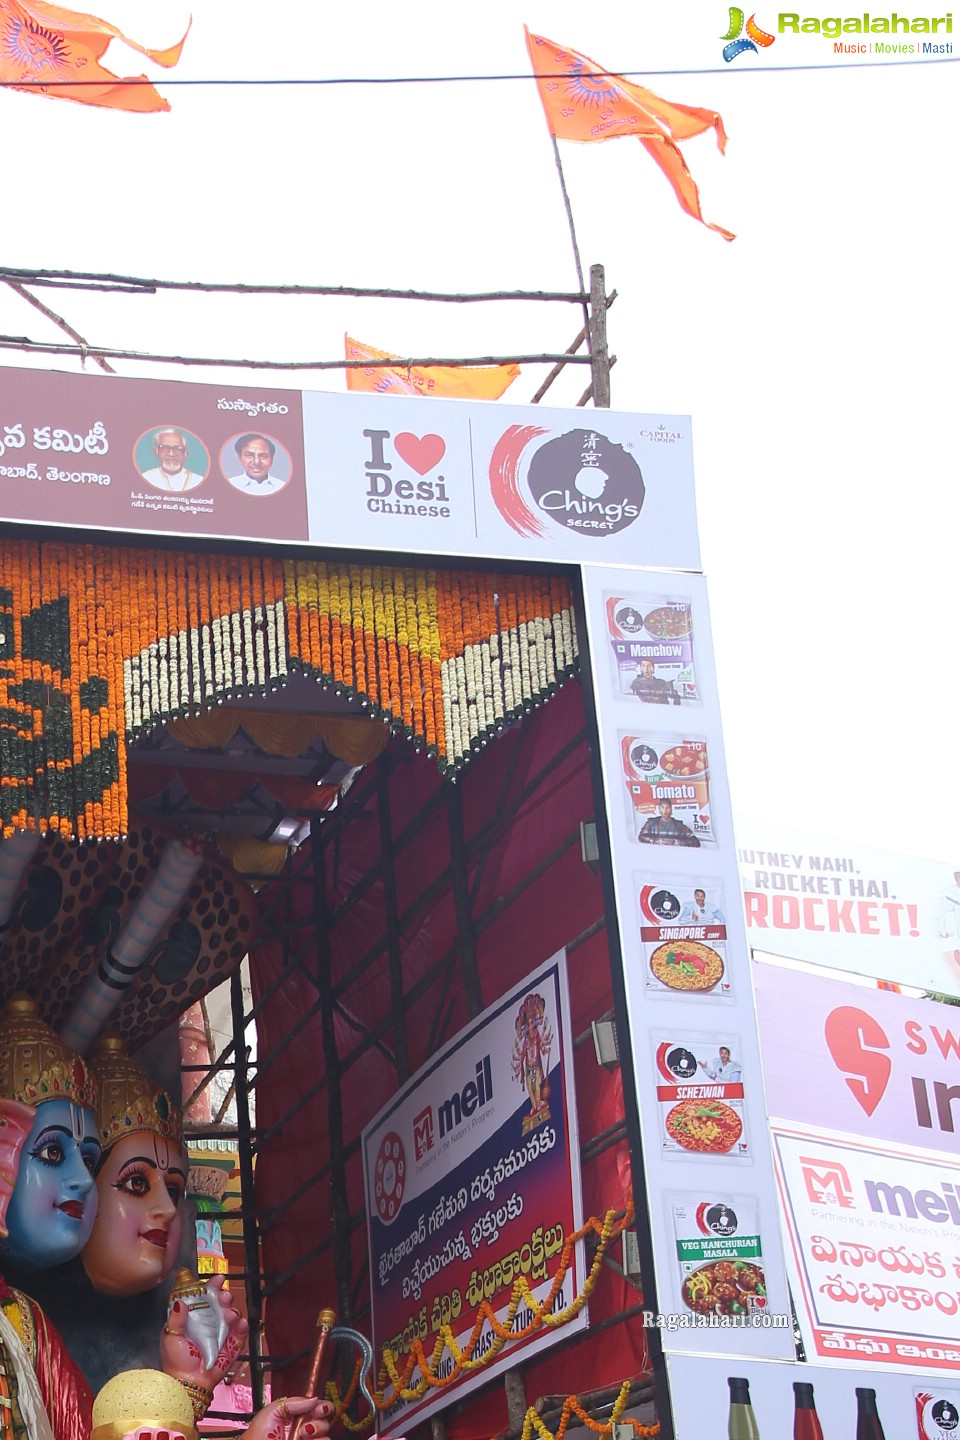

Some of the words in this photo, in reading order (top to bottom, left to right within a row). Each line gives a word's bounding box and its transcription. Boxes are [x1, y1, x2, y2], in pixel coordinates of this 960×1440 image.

[217, 397, 289, 417] సుస్వాగతం
[32, 421, 109, 455] కమిటీ
[640, 430, 684, 440] CAPITAL
[363, 429, 392, 471] I
[46, 467, 111, 485] తెలంగాణ
[365, 472, 450, 502] Desi
[366, 498, 451, 519] Chinese
[539, 490, 639, 523] Ching's
[567, 518, 614, 530] SECRET
[630, 644, 683, 657] Manchow
[650, 785, 695, 799] Tomato
[808, 856, 861, 875] NAHI,
[754, 871, 843, 896] ROCKET
[849, 879, 897, 900] HAI,
[744, 892, 921, 937] ROCKET!
[659, 927, 706, 940] SINGAPORE
[438, 1054, 494, 1140] meil
[676, 1086, 725, 1099] SCHEZWAN
[681, 1242, 699, 1250] VEG
[701, 1238, 758, 1250] MANCHURIAN
[703, 1249, 738, 1258] MASALA
[810, 1235, 947, 1279] వినాయక
[939, 1430, 957, 1438] VEG
